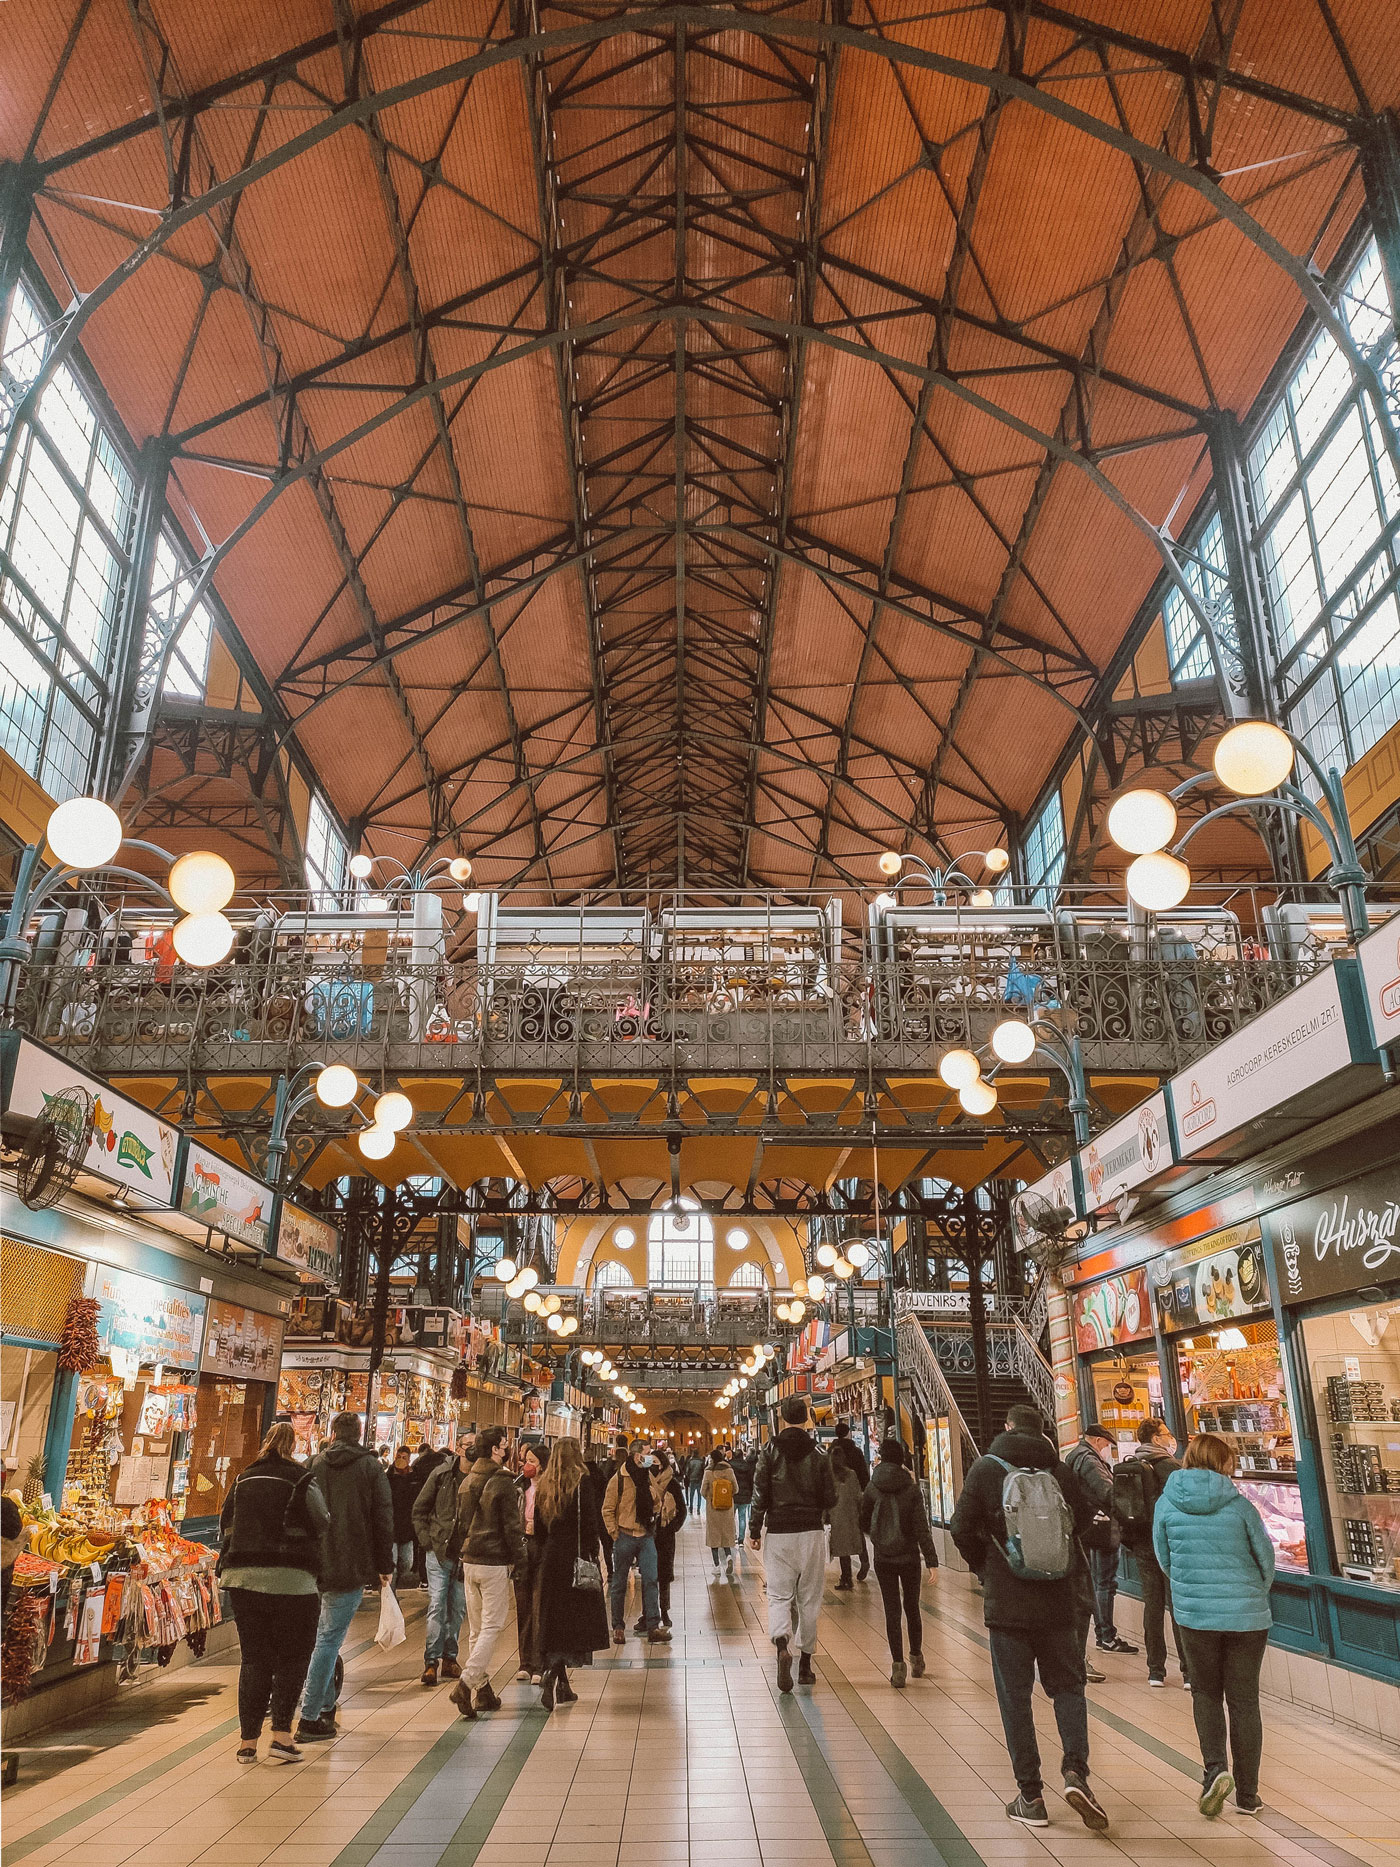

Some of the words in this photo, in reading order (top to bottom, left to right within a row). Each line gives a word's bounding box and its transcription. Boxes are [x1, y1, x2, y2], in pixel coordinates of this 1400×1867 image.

[1227, 1053, 1263, 1086] AGROCORP
[1263, 1018, 1320, 1062] KERESKEDELMI
[1320, 1005, 1339, 1026] ZRT.
[1105, 1146, 1136, 1177] TERMÉKEI
[152, 1296, 191, 1319] pecialities
